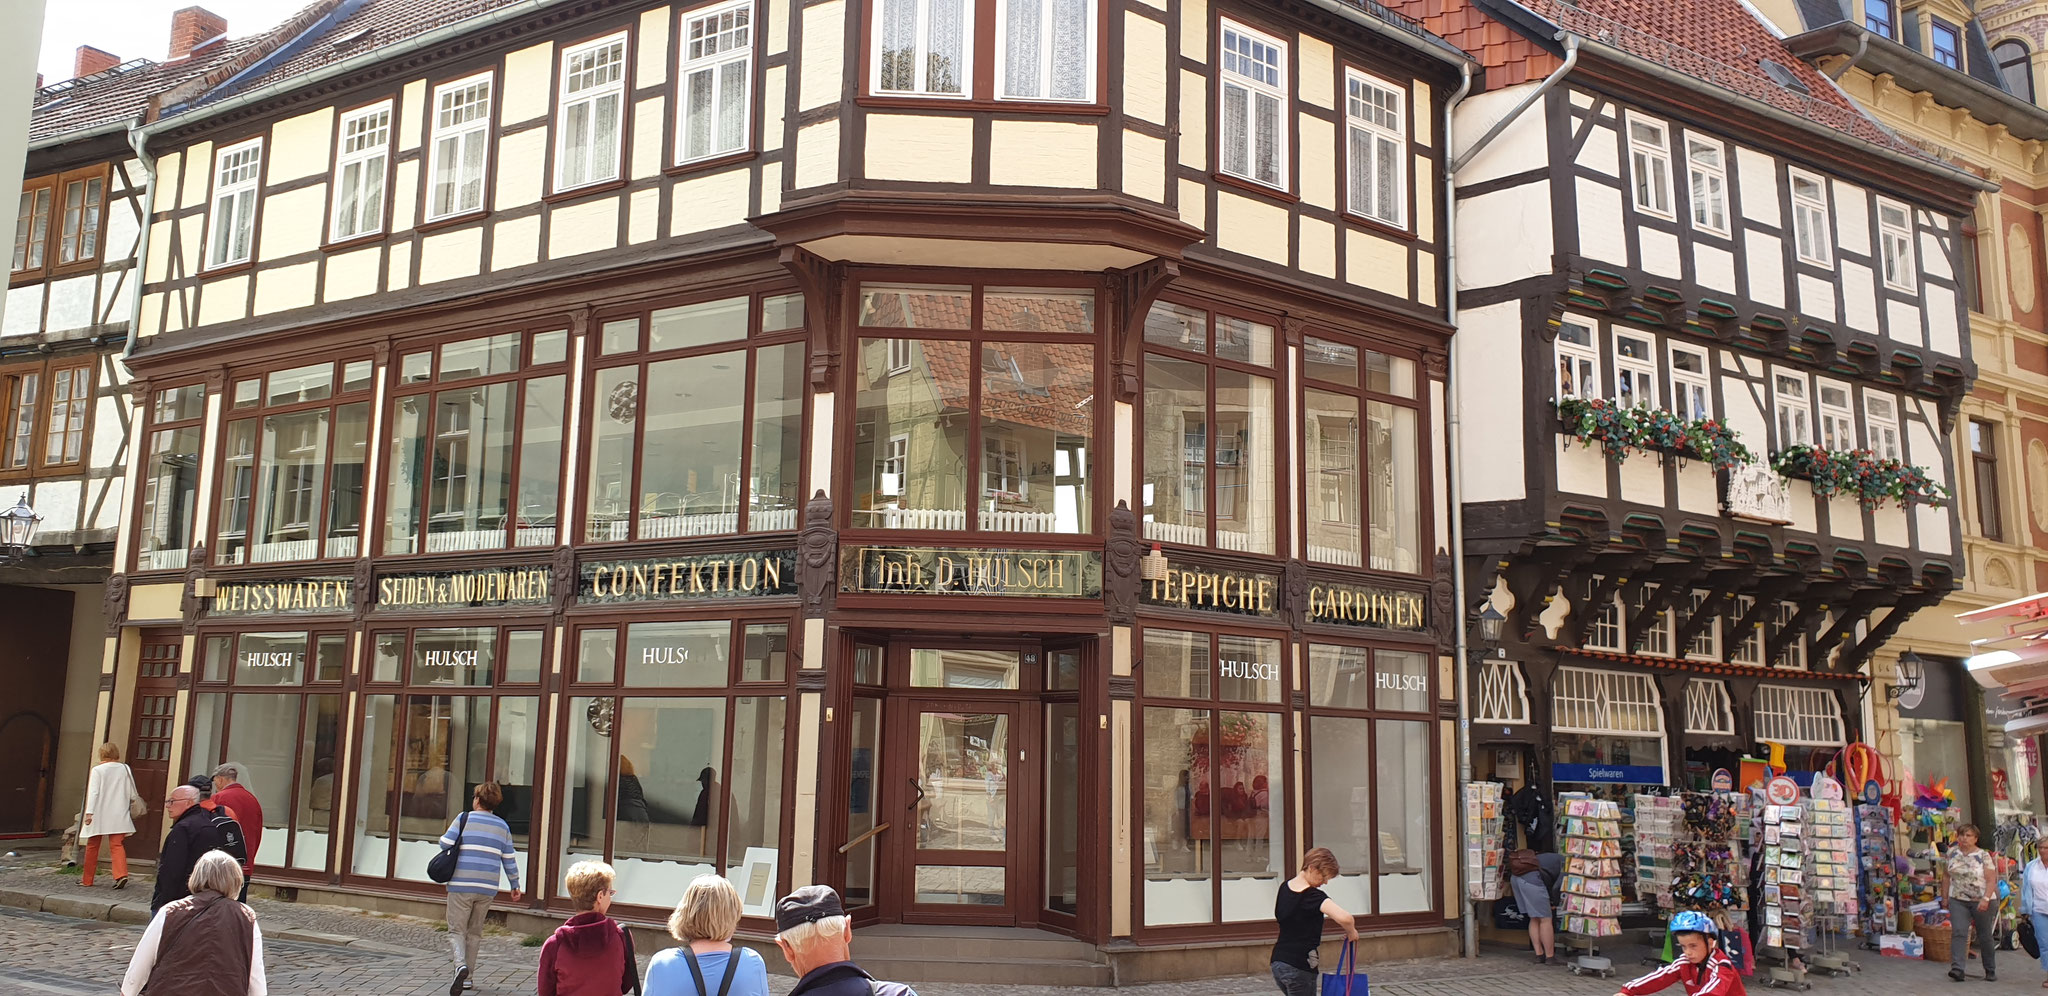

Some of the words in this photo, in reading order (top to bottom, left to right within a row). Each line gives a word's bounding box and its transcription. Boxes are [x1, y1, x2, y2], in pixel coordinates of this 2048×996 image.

[593, 557, 780, 597] CONFEKTION
[878, 554, 929, 586] Inh.
[938, 556, 959, 586] D.
[968, 556, 1064, 588] HULSCH
[215, 580, 348, 611] WEISSWAREN
[449, 570, 548, 602] MODEWAREN
[1310, 586, 1422, 627] GARDINEN
[247, 652, 293, 667] HULSCH
[425, 650, 478, 666] HULSCH
[1025, 654, 1036, 663] 48
[1220, 659, 1279, 681] HULSCH
[1375, 672, 1426, 691] HULSCH
[1588, 767, 1624, 780] Spielwaren
